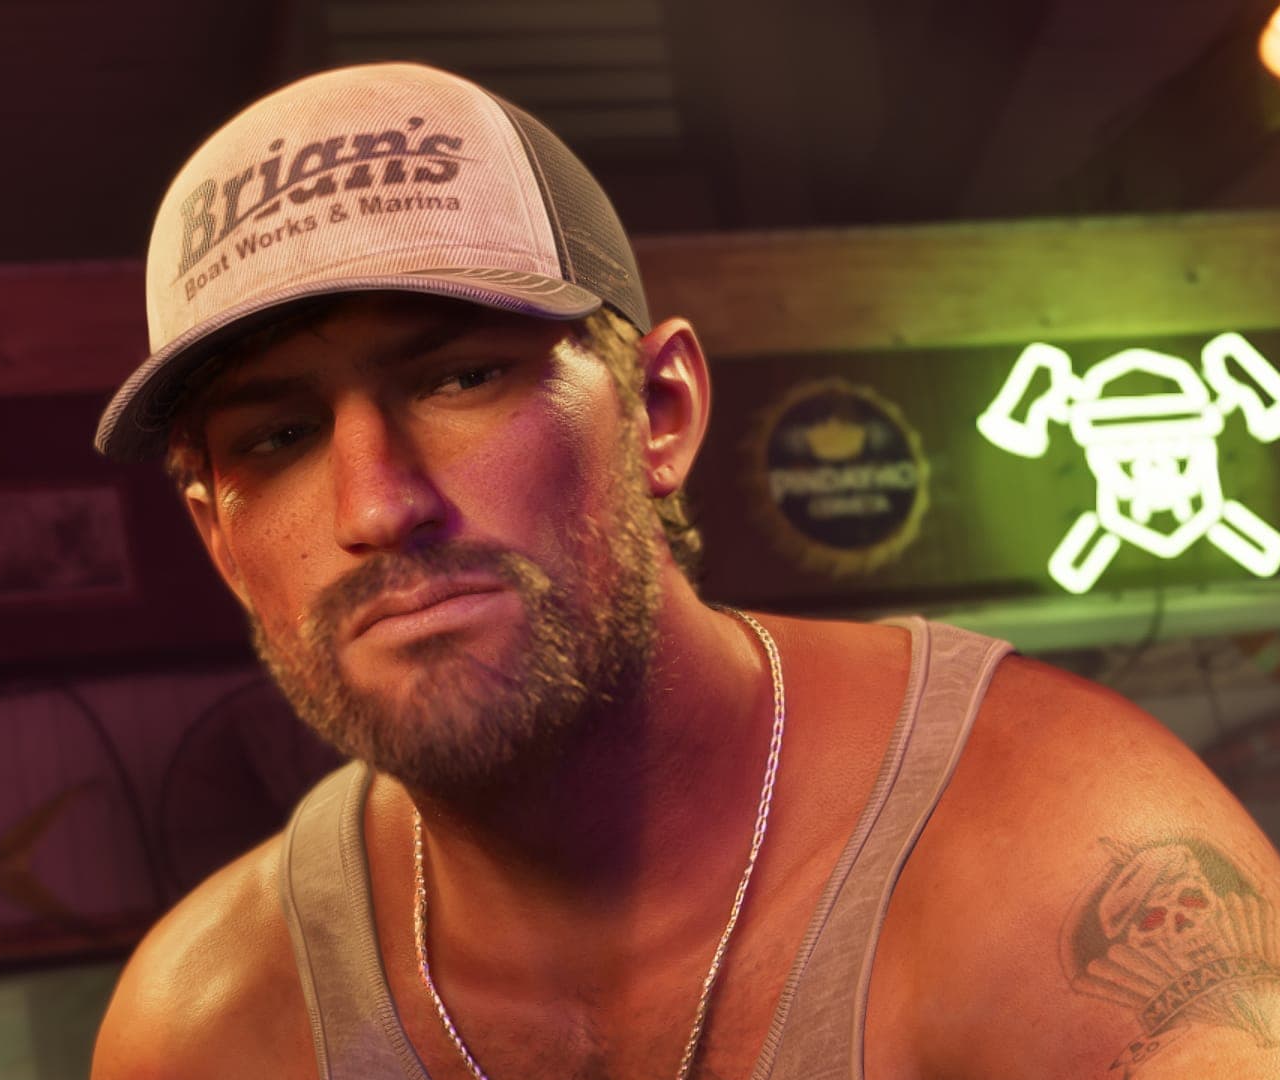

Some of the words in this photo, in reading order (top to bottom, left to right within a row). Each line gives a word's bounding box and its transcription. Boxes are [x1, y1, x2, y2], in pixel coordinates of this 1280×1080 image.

[175, 116, 465, 277] Brian's
[184, 253, 231, 301] Boat
[234, 214, 319, 260] Works
[329, 202, 349, 225] &
[358, 192, 462, 218] Marina
